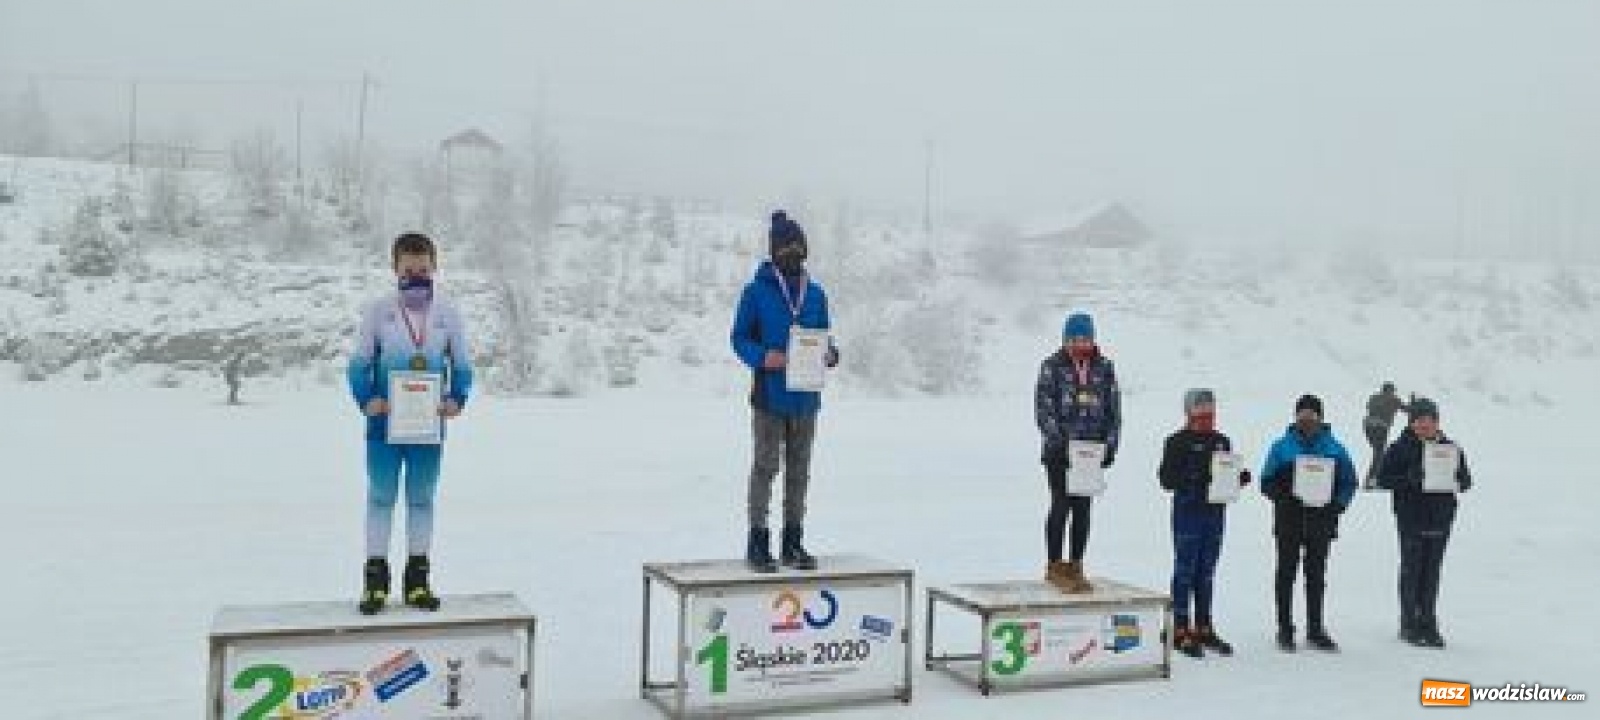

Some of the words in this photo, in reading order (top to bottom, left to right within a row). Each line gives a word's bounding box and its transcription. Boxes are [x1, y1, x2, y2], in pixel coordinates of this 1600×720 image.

[696, 634, 729, 693] 1
[812, 639, 871, 665] 2020
[990, 621, 1028, 675] 3
[232, 663, 294, 720] 2
